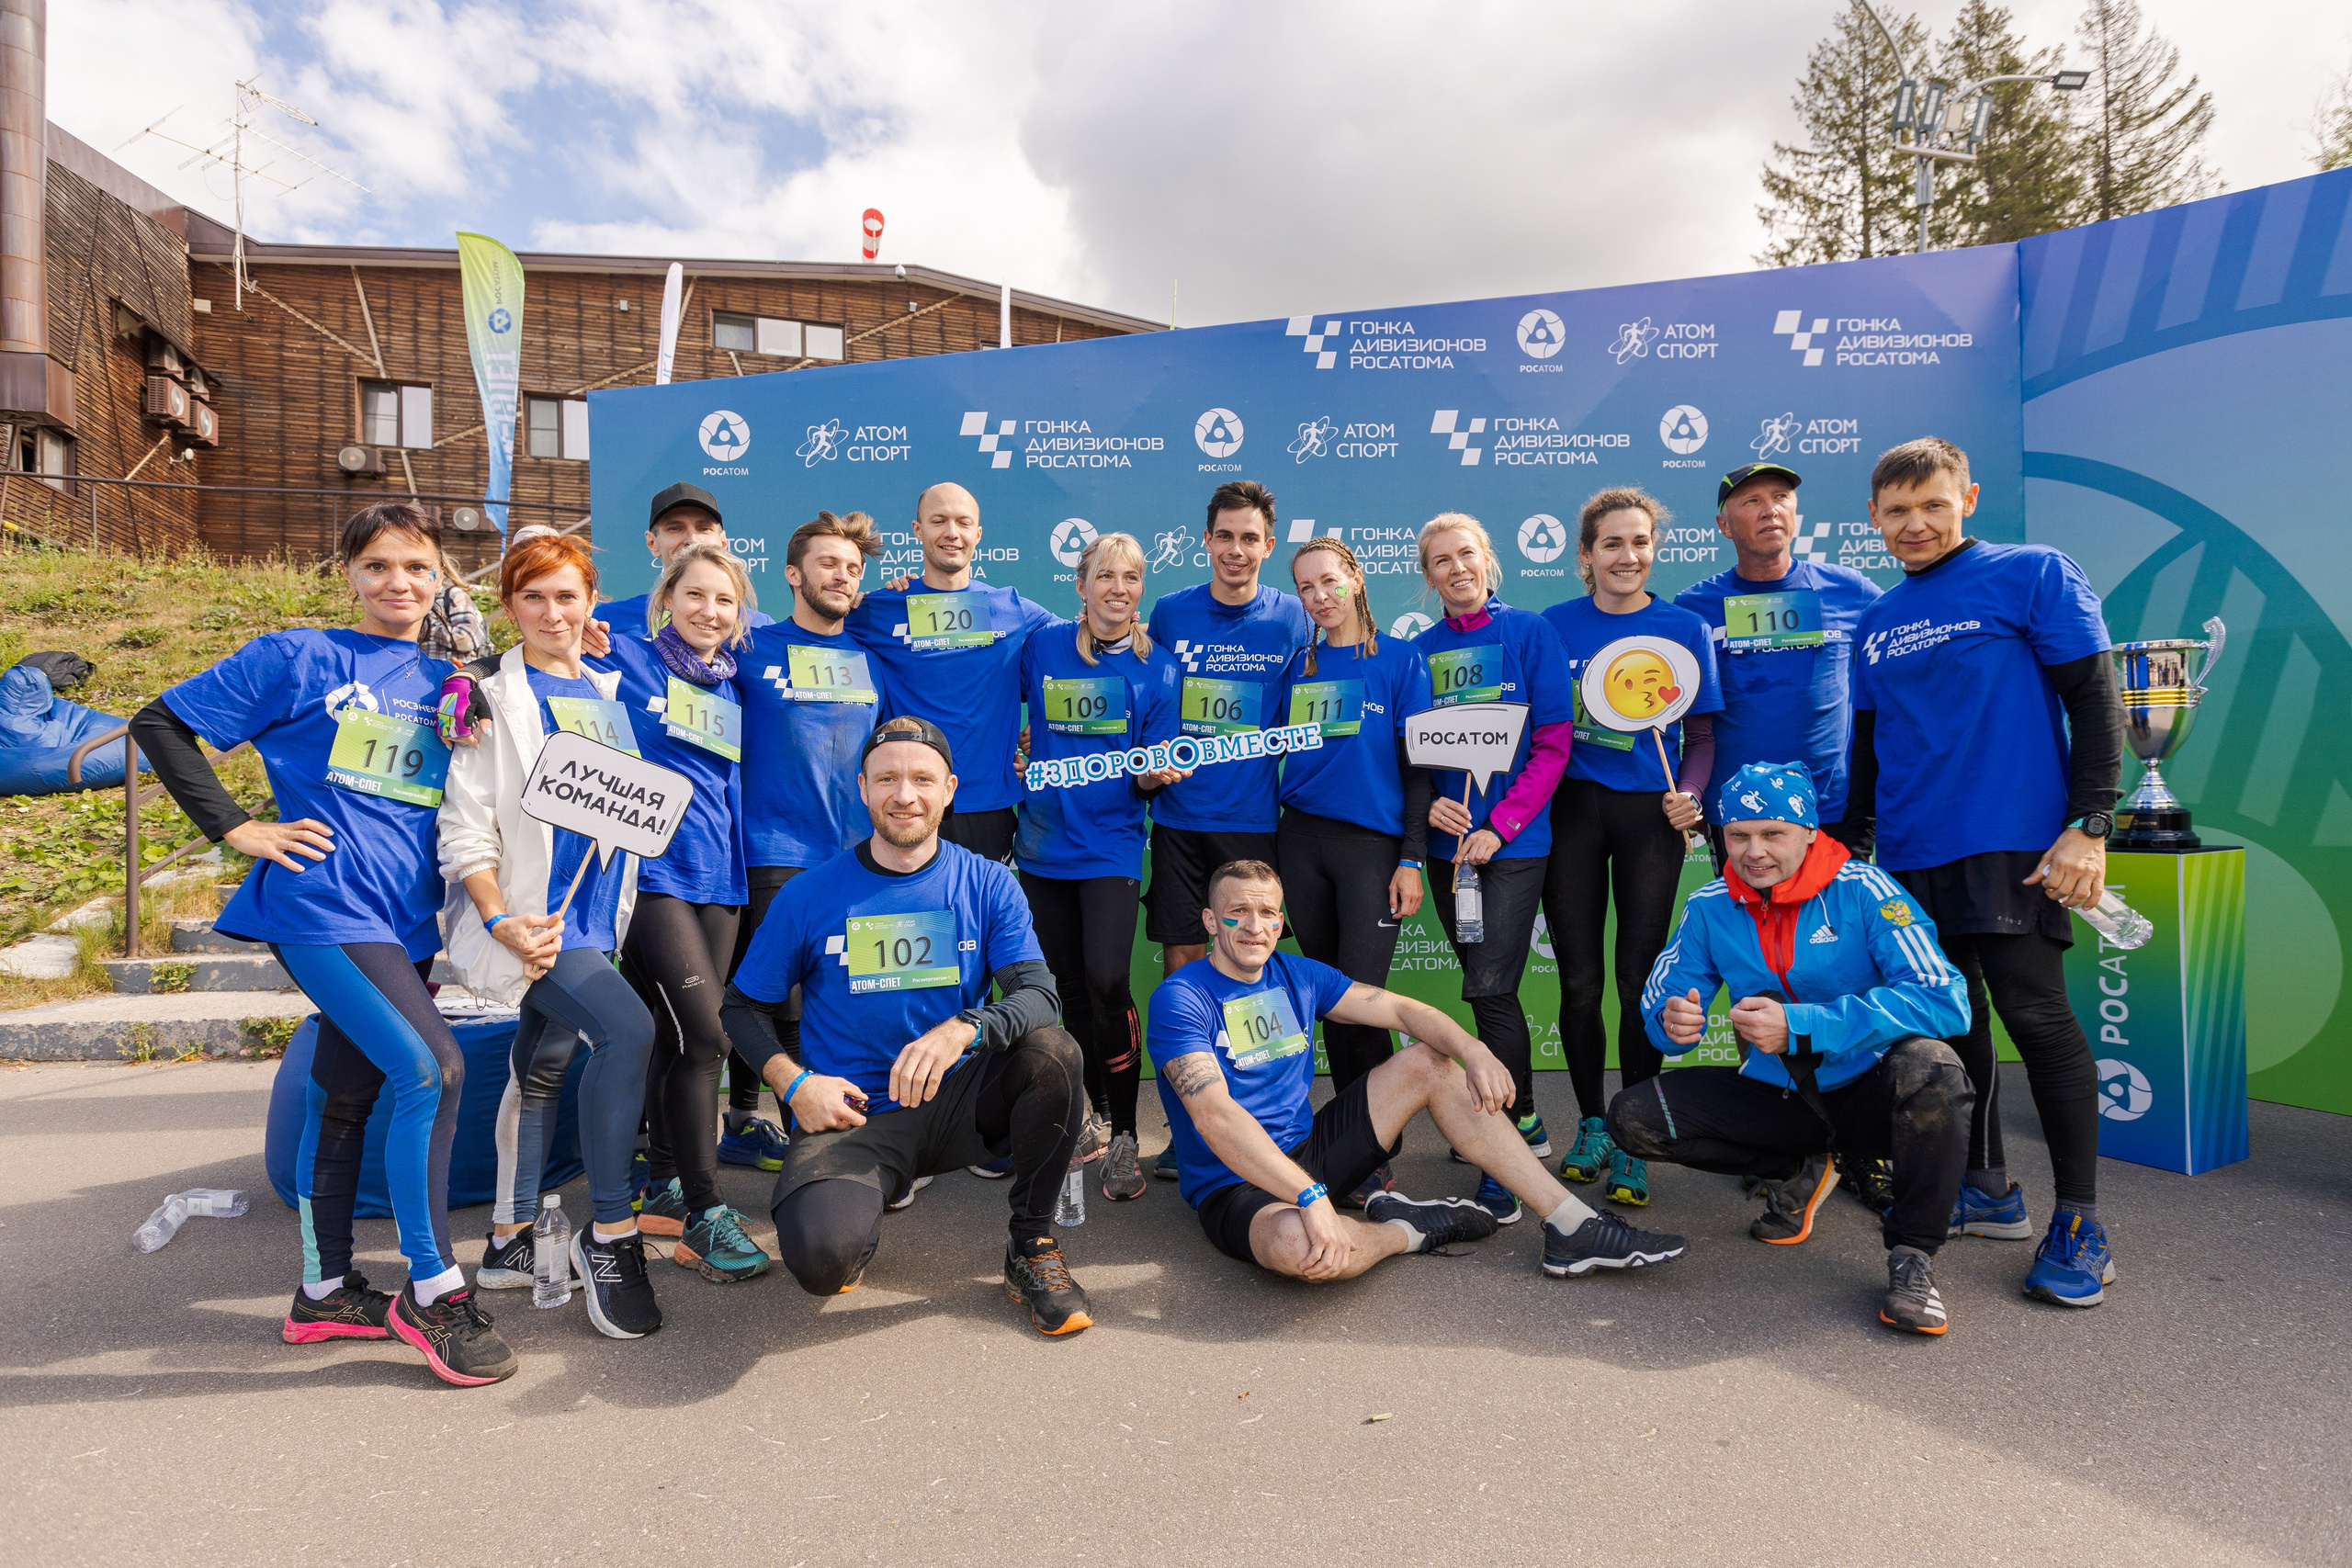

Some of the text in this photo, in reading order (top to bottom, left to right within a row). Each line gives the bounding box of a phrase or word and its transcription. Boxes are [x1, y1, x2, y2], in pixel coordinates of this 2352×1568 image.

[1350, 321, 1416, 334] ГОНКА
[1664, 323, 1715, 339] АТОМ
[1836, 318, 1902, 332] ГОНКА
[1350, 338, 1487, 355] ДИВИЗИОНОВ
[1836, 333, 1973, 351] ДИВИЗИОНОВ
[1657, 344, 1719, 358] СПОРТ
[1350, 355, 1454, 369] РОСАТОМА
[1836, 352, 1940, 366] РОСАТОМА
[1519, 365, 1564, 373] РОСАТОМ
[1024, 420, 1091, 434] ГОНКА
[1343, 423, 1395, 438] АТОМ
[1494, 418, 1560, 432] ГОНКА
[1806, 419, 1858, 434] АТОМ
[854, 425, 908, 442] АТОМ
[1024, 437, 1164, 453] ДИВИЗИОНОВ
[1494, 434, 1630, 450] ДИВИЗИОНОВ
[1799, 438, 1861, 454] СПОРТ
[846, 446, 911, 461] СПОРТ
[1336, 443, 1399, 458] СПОРТ
[1495, 451, 1599, 465] РОСАТОМА
[1025, 455, 1132, 468] РОСАТОМА
[1198, 464, 1242, 472] РОСАТОМ
[1663, 460, 1706, 468] РОСАТОМ
[703, 468, 749, 476] РОСАТОМ
[1351, 528, 1416, 541] ГОНКА
[1664, 528, 1715, 543] АТОМ
[1838, 523, 1881, 536] ГОН
[726, 537, 765, 553] ТОМ
[879, 532, 922, 546] ГОН
[880, 547, 1019, 564] ДИВОНОВ
[1353, 545, 1419, 559] ДИВИЗ
[1657, 547, 1719, 563] СПОРТ
[738, 558, 769, 573] ОРТ
[1359, 562, 1423, 575] РОСАТО
[1839, 555, 1899, 569] РОСАТ
[1054, 574, 1078, 582] РОСА
[927, 608, 973, 632] 120
[1747, 609, 1799, 633] 110
[1890, 618, 1930, 637] ГОНКА
[1887, 620, 1981, 649] ДИВИЗИОНОВ
[913, 637, 950, 649] АТОМ-СЛЕТ
[1729, 638, 1772, 649] АТОМ-СЛЕТ
[1886, 634, 1951, 659] РОСАТОМА
[1205, 654, 1283, 663] ДИВИЗИОНОВ
[1205, 663, 1266, 671] РОСАТОМА
[809, 664, 853, 686] 113
[1442, 663, 1483, 691] 108
[795, 691, 832, 699] АТОМ-СЛЕТ
[1433, 695, 1458, 706] ОМ-СЛЕТ
[392, 698, 437, 713] РОСЭНЕР
[1062, 695, 1108, 718] 109
[1200, 696, 1242, 720] 106
[1306, 698, 1342, 721] 111
[685, 704, 724, 736] 115
[1048, 723, 1083, 732] АТОМ-СЛЕТ
[575, 719, 619, 745] 114
[669, 724, 704, 745] АТОМ-СЛЕТ
[1182, 723, 1216, 734] АТОМ-СЛЕТ
[1573, 730, 1590, 740] -СЛЕТ
[1419, 731, 1508, 745] РОСАТОМ
[364, 739, 424, 777] 119
[1028, 725, 1320, 788] #ЗДОРОВОВМЕСТЕ
[325, 771, 382, 792] АТОМ-СЛЕТ
[560, 761, 665, 810] ЛУЧШАЯ
[537, 774, 666, 836] КОМАНДА!
[1683, 854, 1711, 863] САТОМ
[1809, 935, 1838, 944] adidas
[874, 936, 933, 968] 102
[1389, 957, 1462, 971] САТОМА
[2098, 885, 2130, 1045] РОСАТ
[852, 976, 901, 991] АТОМ-СЛЕТ
[1243, 1010, 1283, 1045] 104
[1238, 1049, 1270, 1067] АТОМ-СЛЕТ
